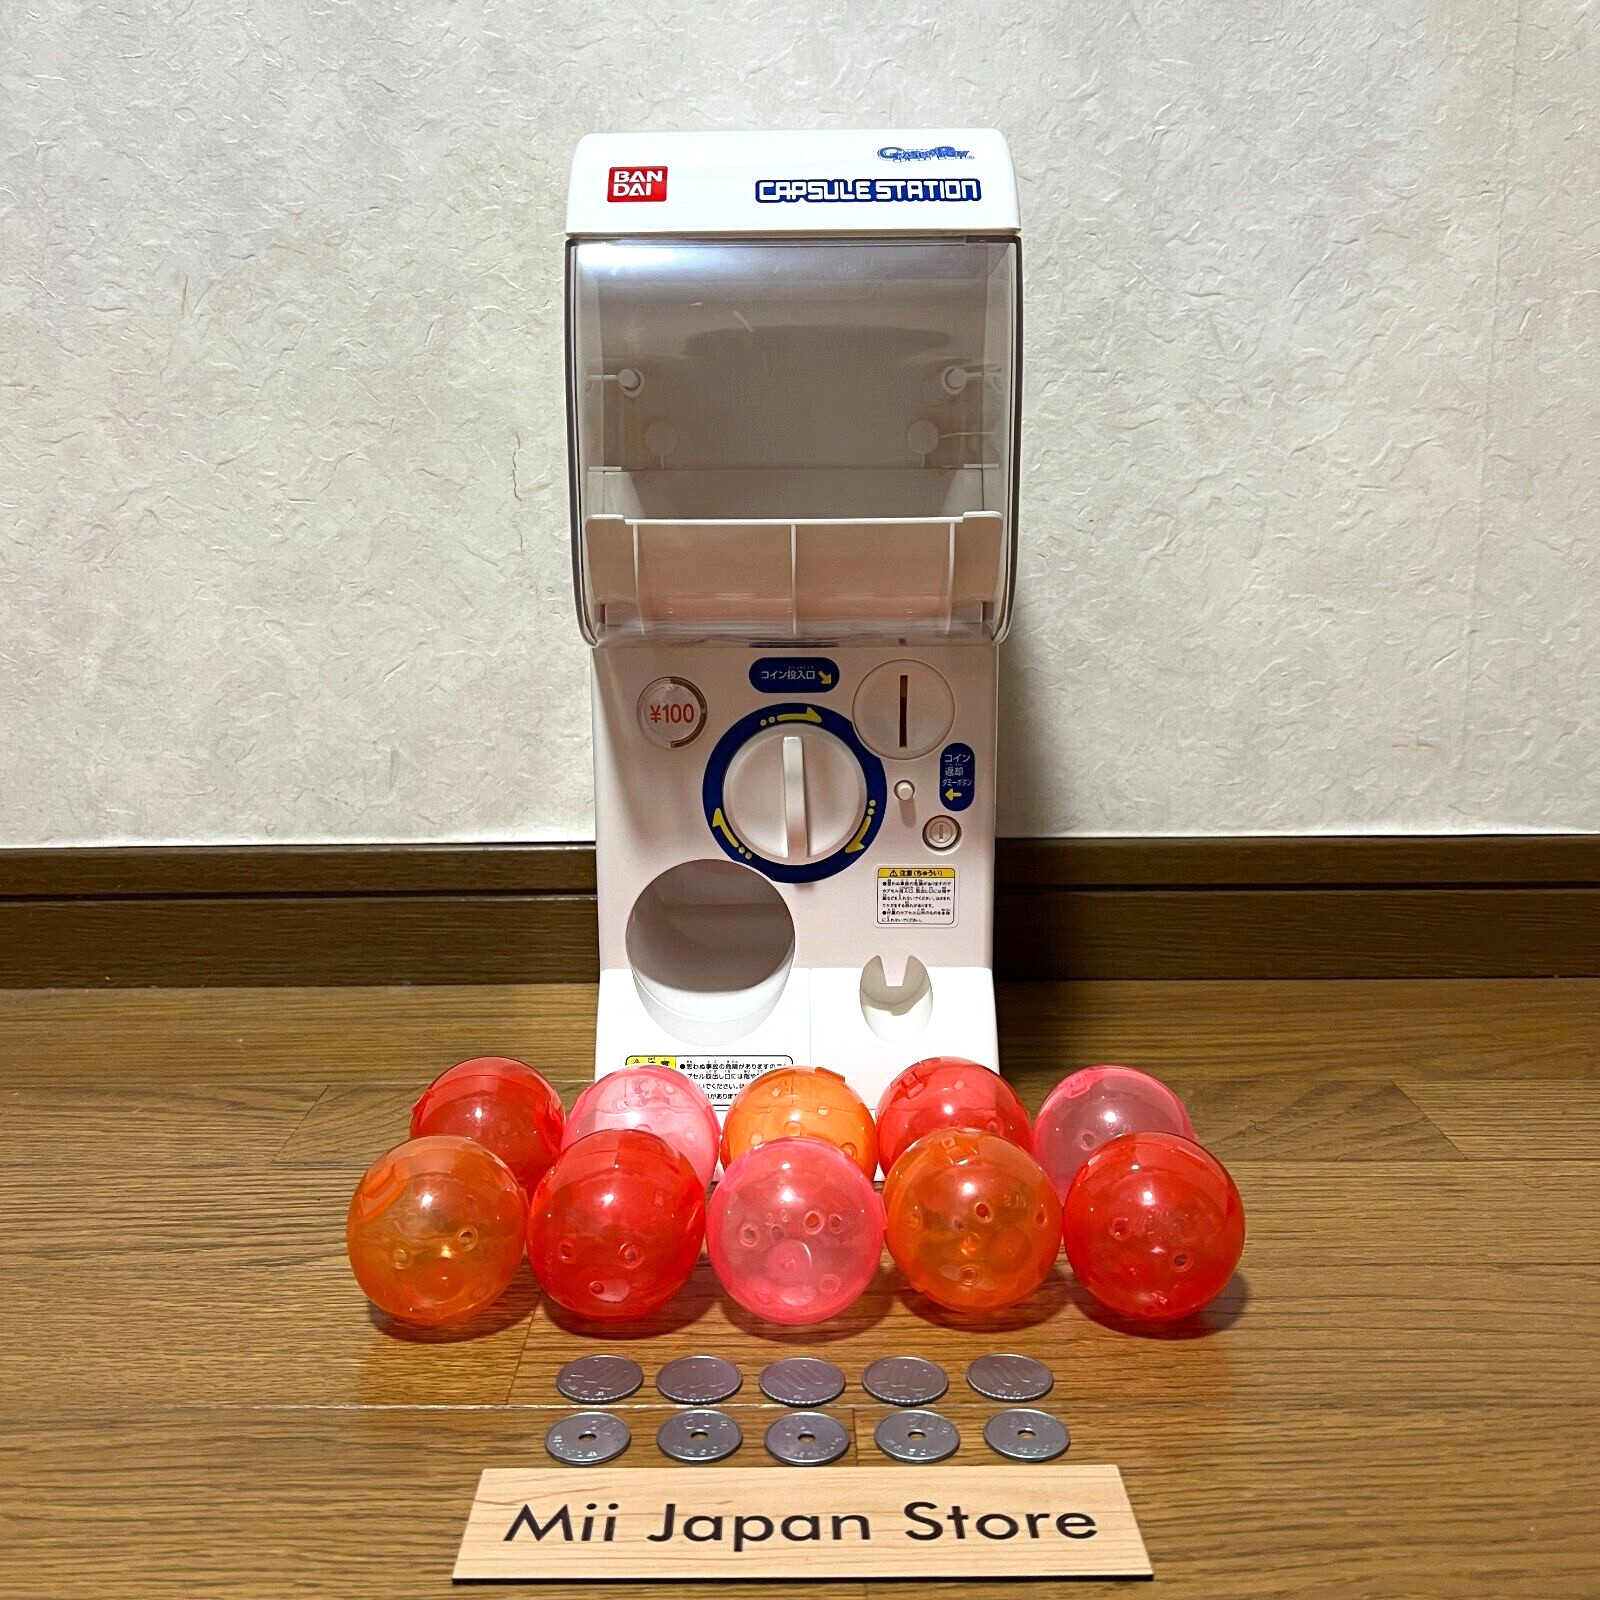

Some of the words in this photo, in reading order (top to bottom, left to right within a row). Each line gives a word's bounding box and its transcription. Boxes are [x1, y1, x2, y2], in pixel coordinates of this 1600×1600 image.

[613, 170, 663, 183] BAN
[612, 183, 652, 197] DAI
[758, 180, 873, 201] CAPSULE
[874, 179, 979, 200] STATION
[760, 670, 816, 680] コイン投入口
[649, 703, 695, 724] ¥100
[944, 753, 971, 763] コイン
[503, 1503, 620, 1542] Mii
[646, 1503, 872, 1553] Japan
[903, 1501, 1099, 1541] Store
